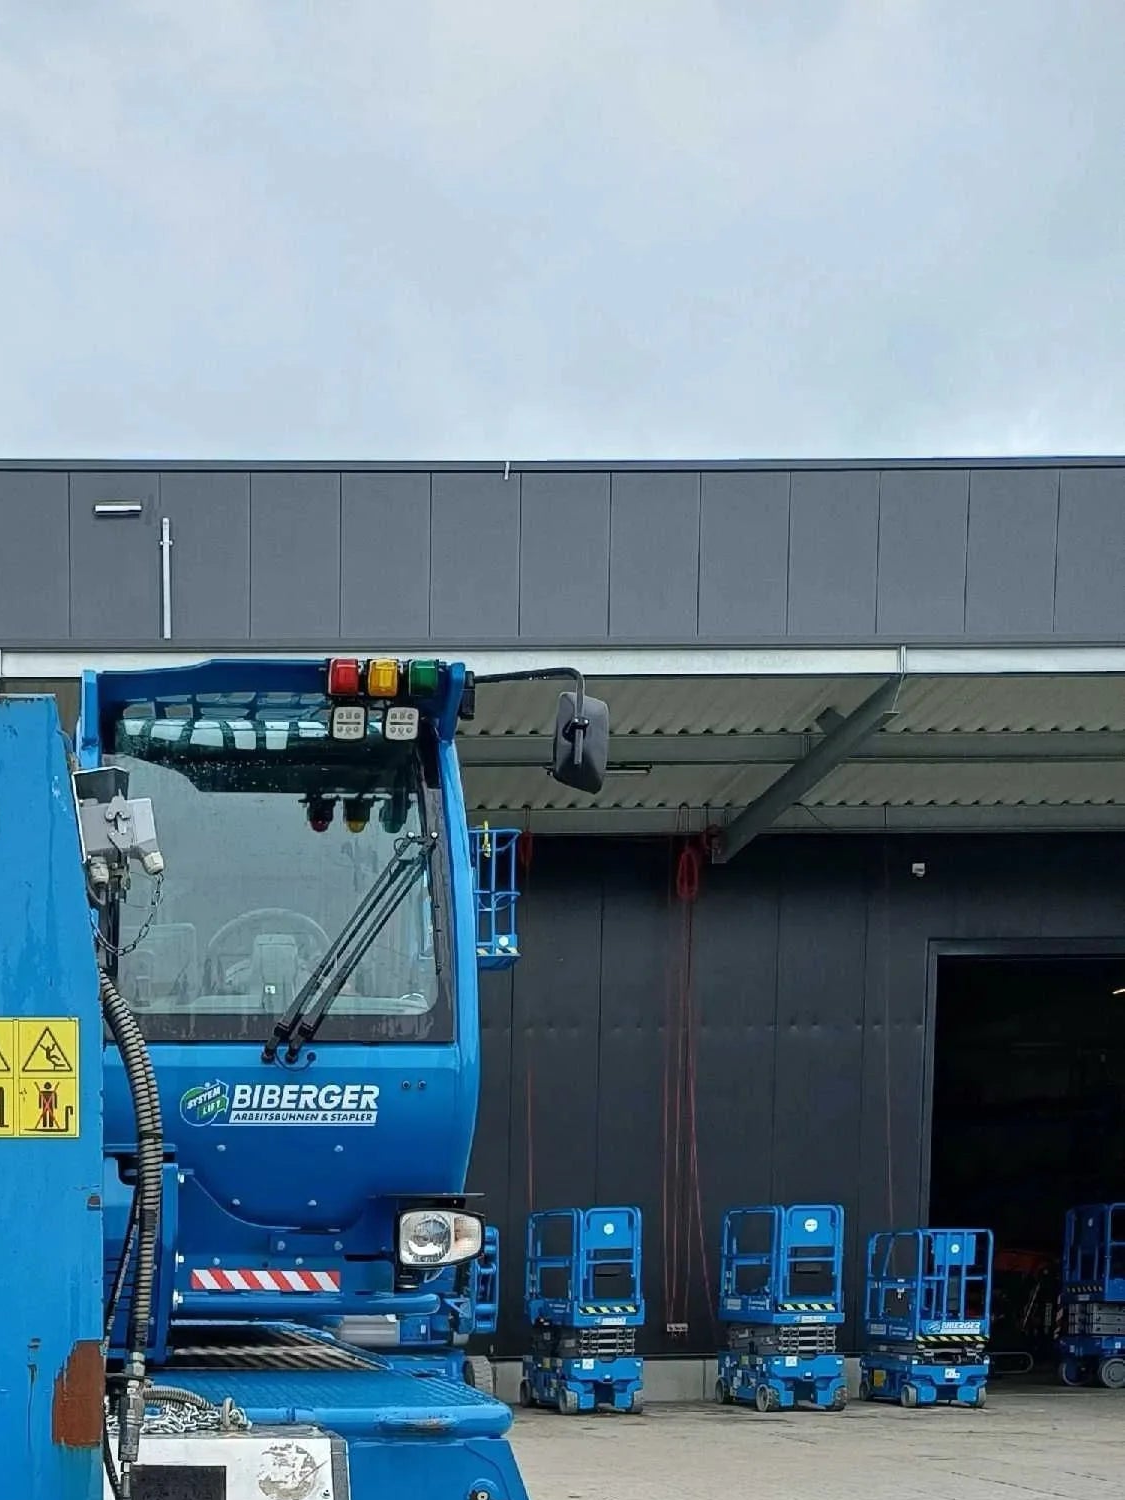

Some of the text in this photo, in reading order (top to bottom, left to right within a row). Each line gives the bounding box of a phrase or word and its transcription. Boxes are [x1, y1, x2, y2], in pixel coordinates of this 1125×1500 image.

[186, 1086, 221, 1110] SYSTEM
[202, 1099, 222, 1115] LIFT
[232, 1084, 380, 1110] BIBERGER
[320, 1112, 329, 1122] &
[330, 1112, 373, 1122] STAPLER
